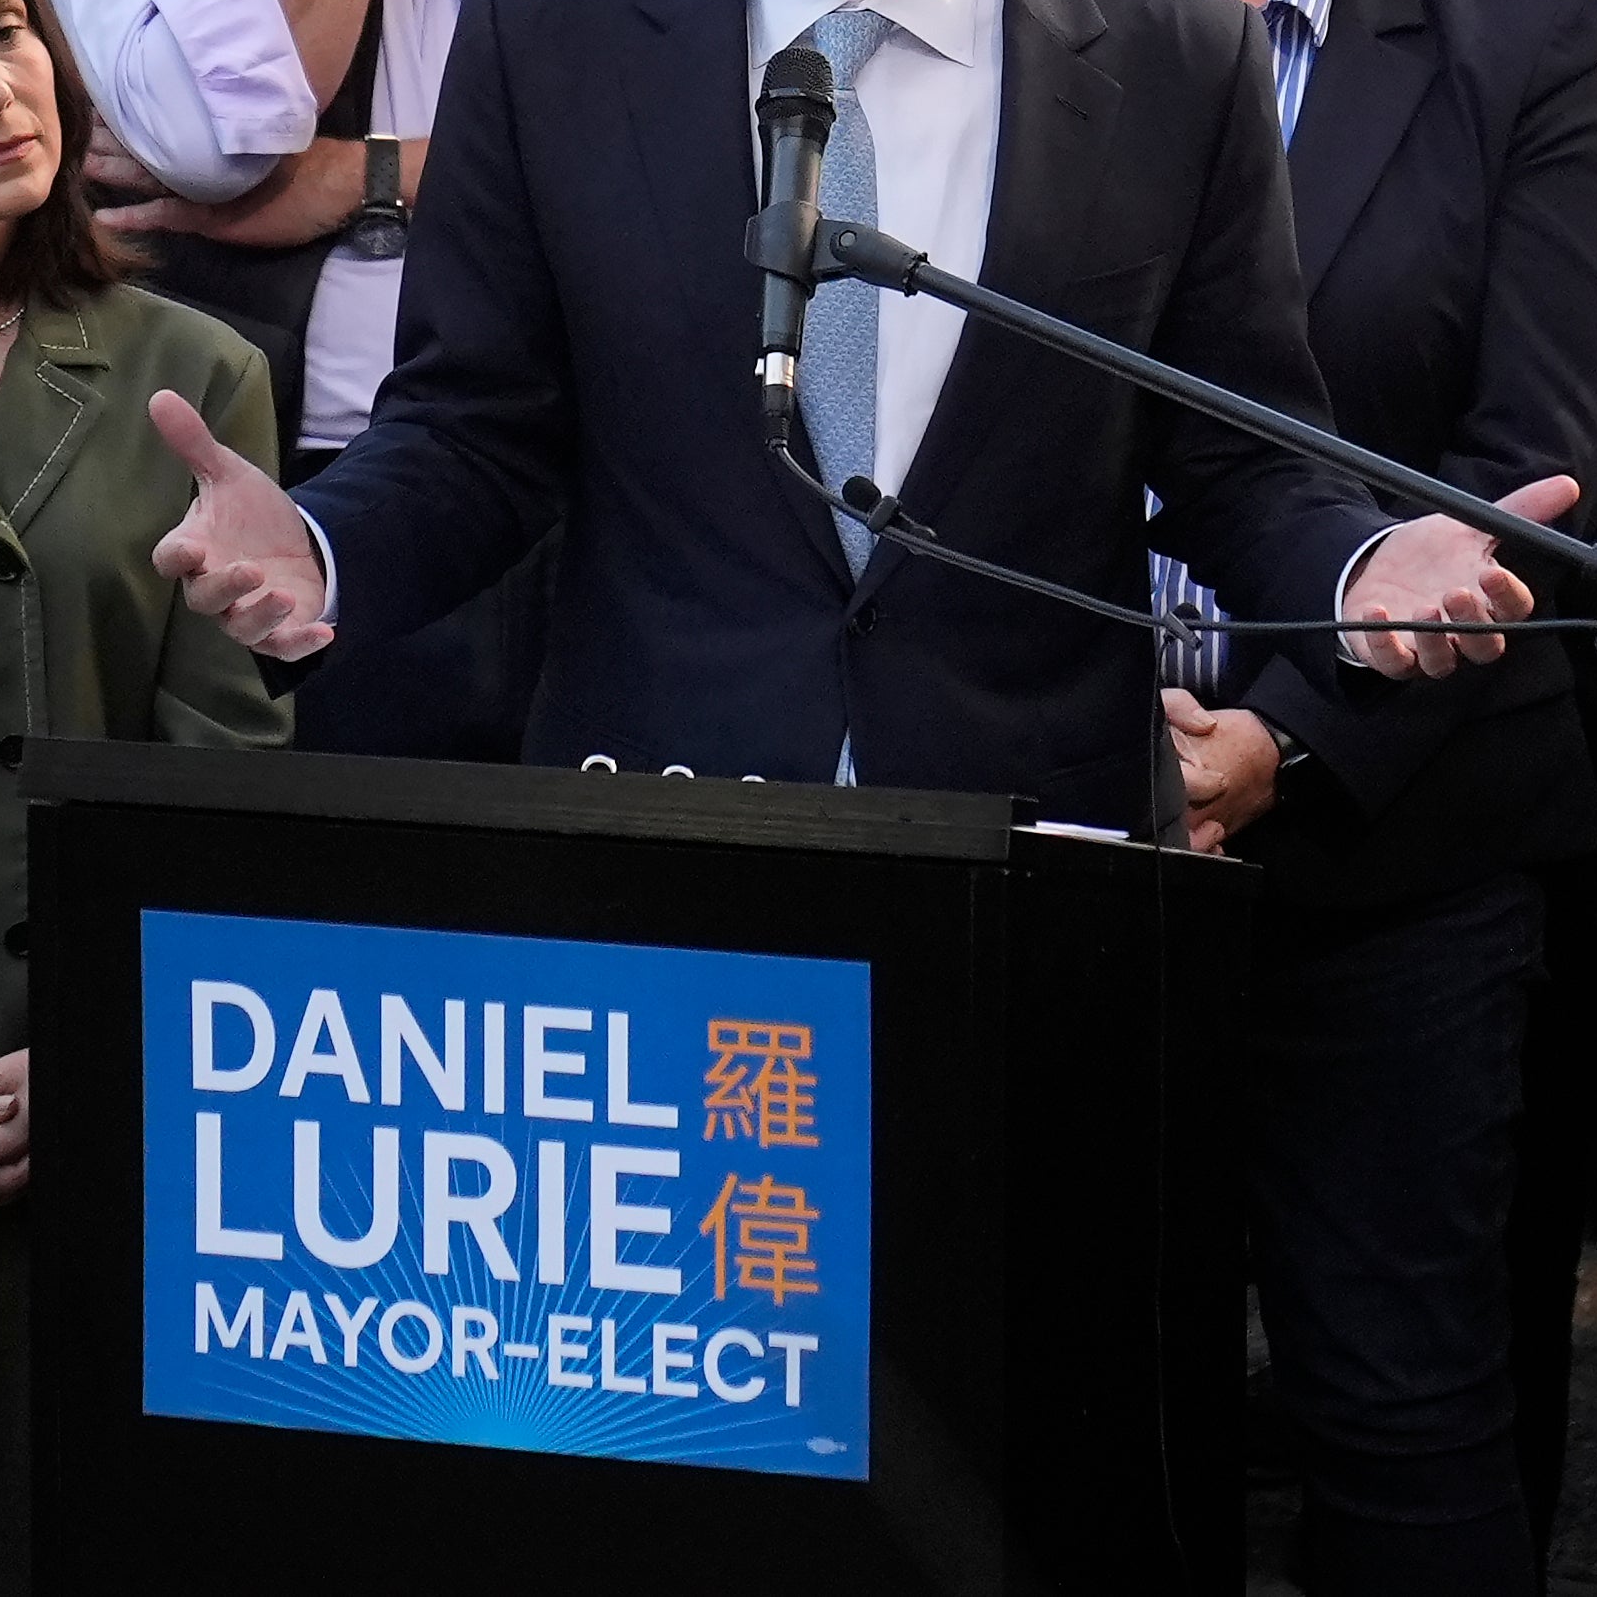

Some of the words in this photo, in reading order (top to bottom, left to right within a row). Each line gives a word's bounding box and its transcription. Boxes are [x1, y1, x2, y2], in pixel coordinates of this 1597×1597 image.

[191, 980, 679, 1129] DANIEL
[195, 1111, 682, 1296] LURIE
[701, 1018, 821, 1304] 羅偉
[194, 1282, 819, 1407] MAYOR-ELECT
